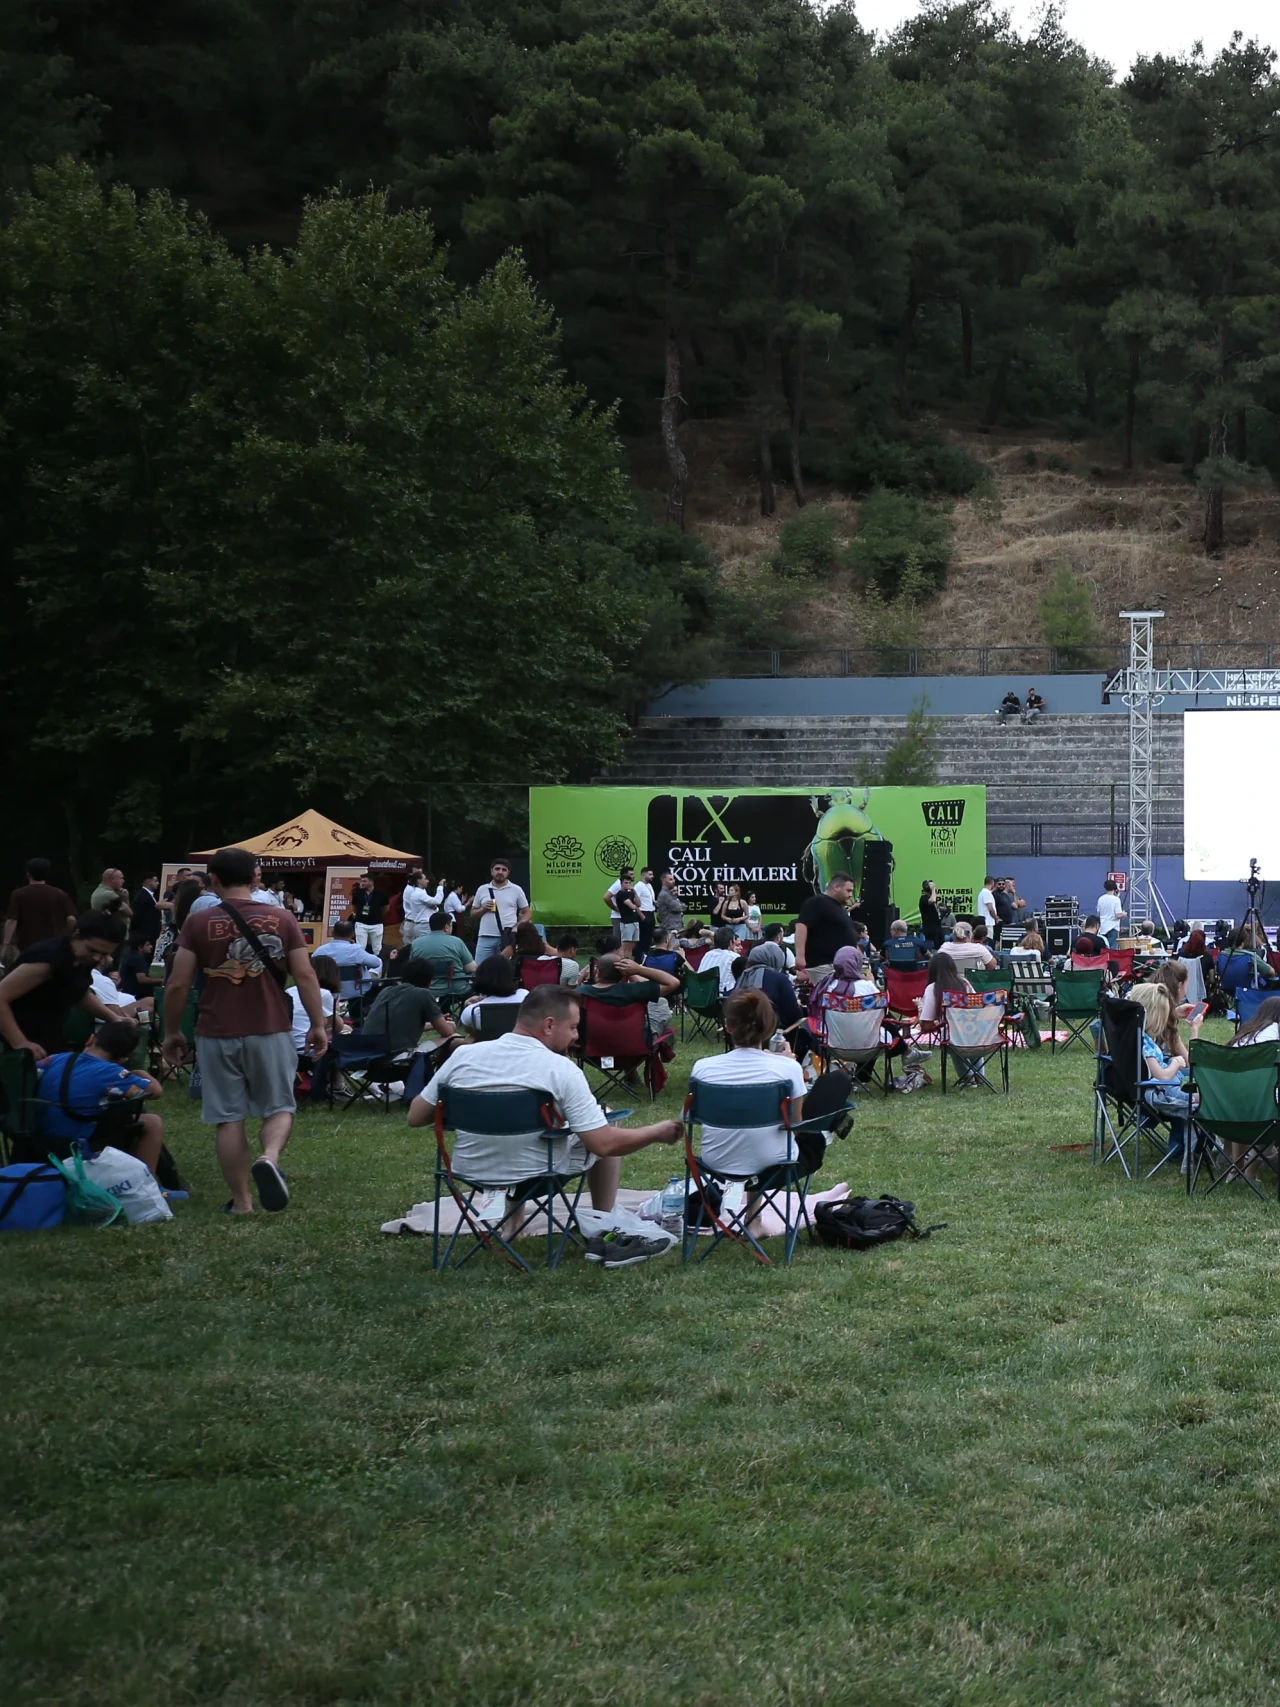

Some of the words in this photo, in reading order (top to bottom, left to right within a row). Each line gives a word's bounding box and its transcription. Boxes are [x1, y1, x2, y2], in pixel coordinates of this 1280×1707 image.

[670, 794, 751, 844] IX.
[546, 860, 582, 868] NİLÜFER
[668, 847, 712, 865] ÇALI
[669, 863, 710, 882] KÖY
[712, 863, 798, 882] FİLMLERİ
